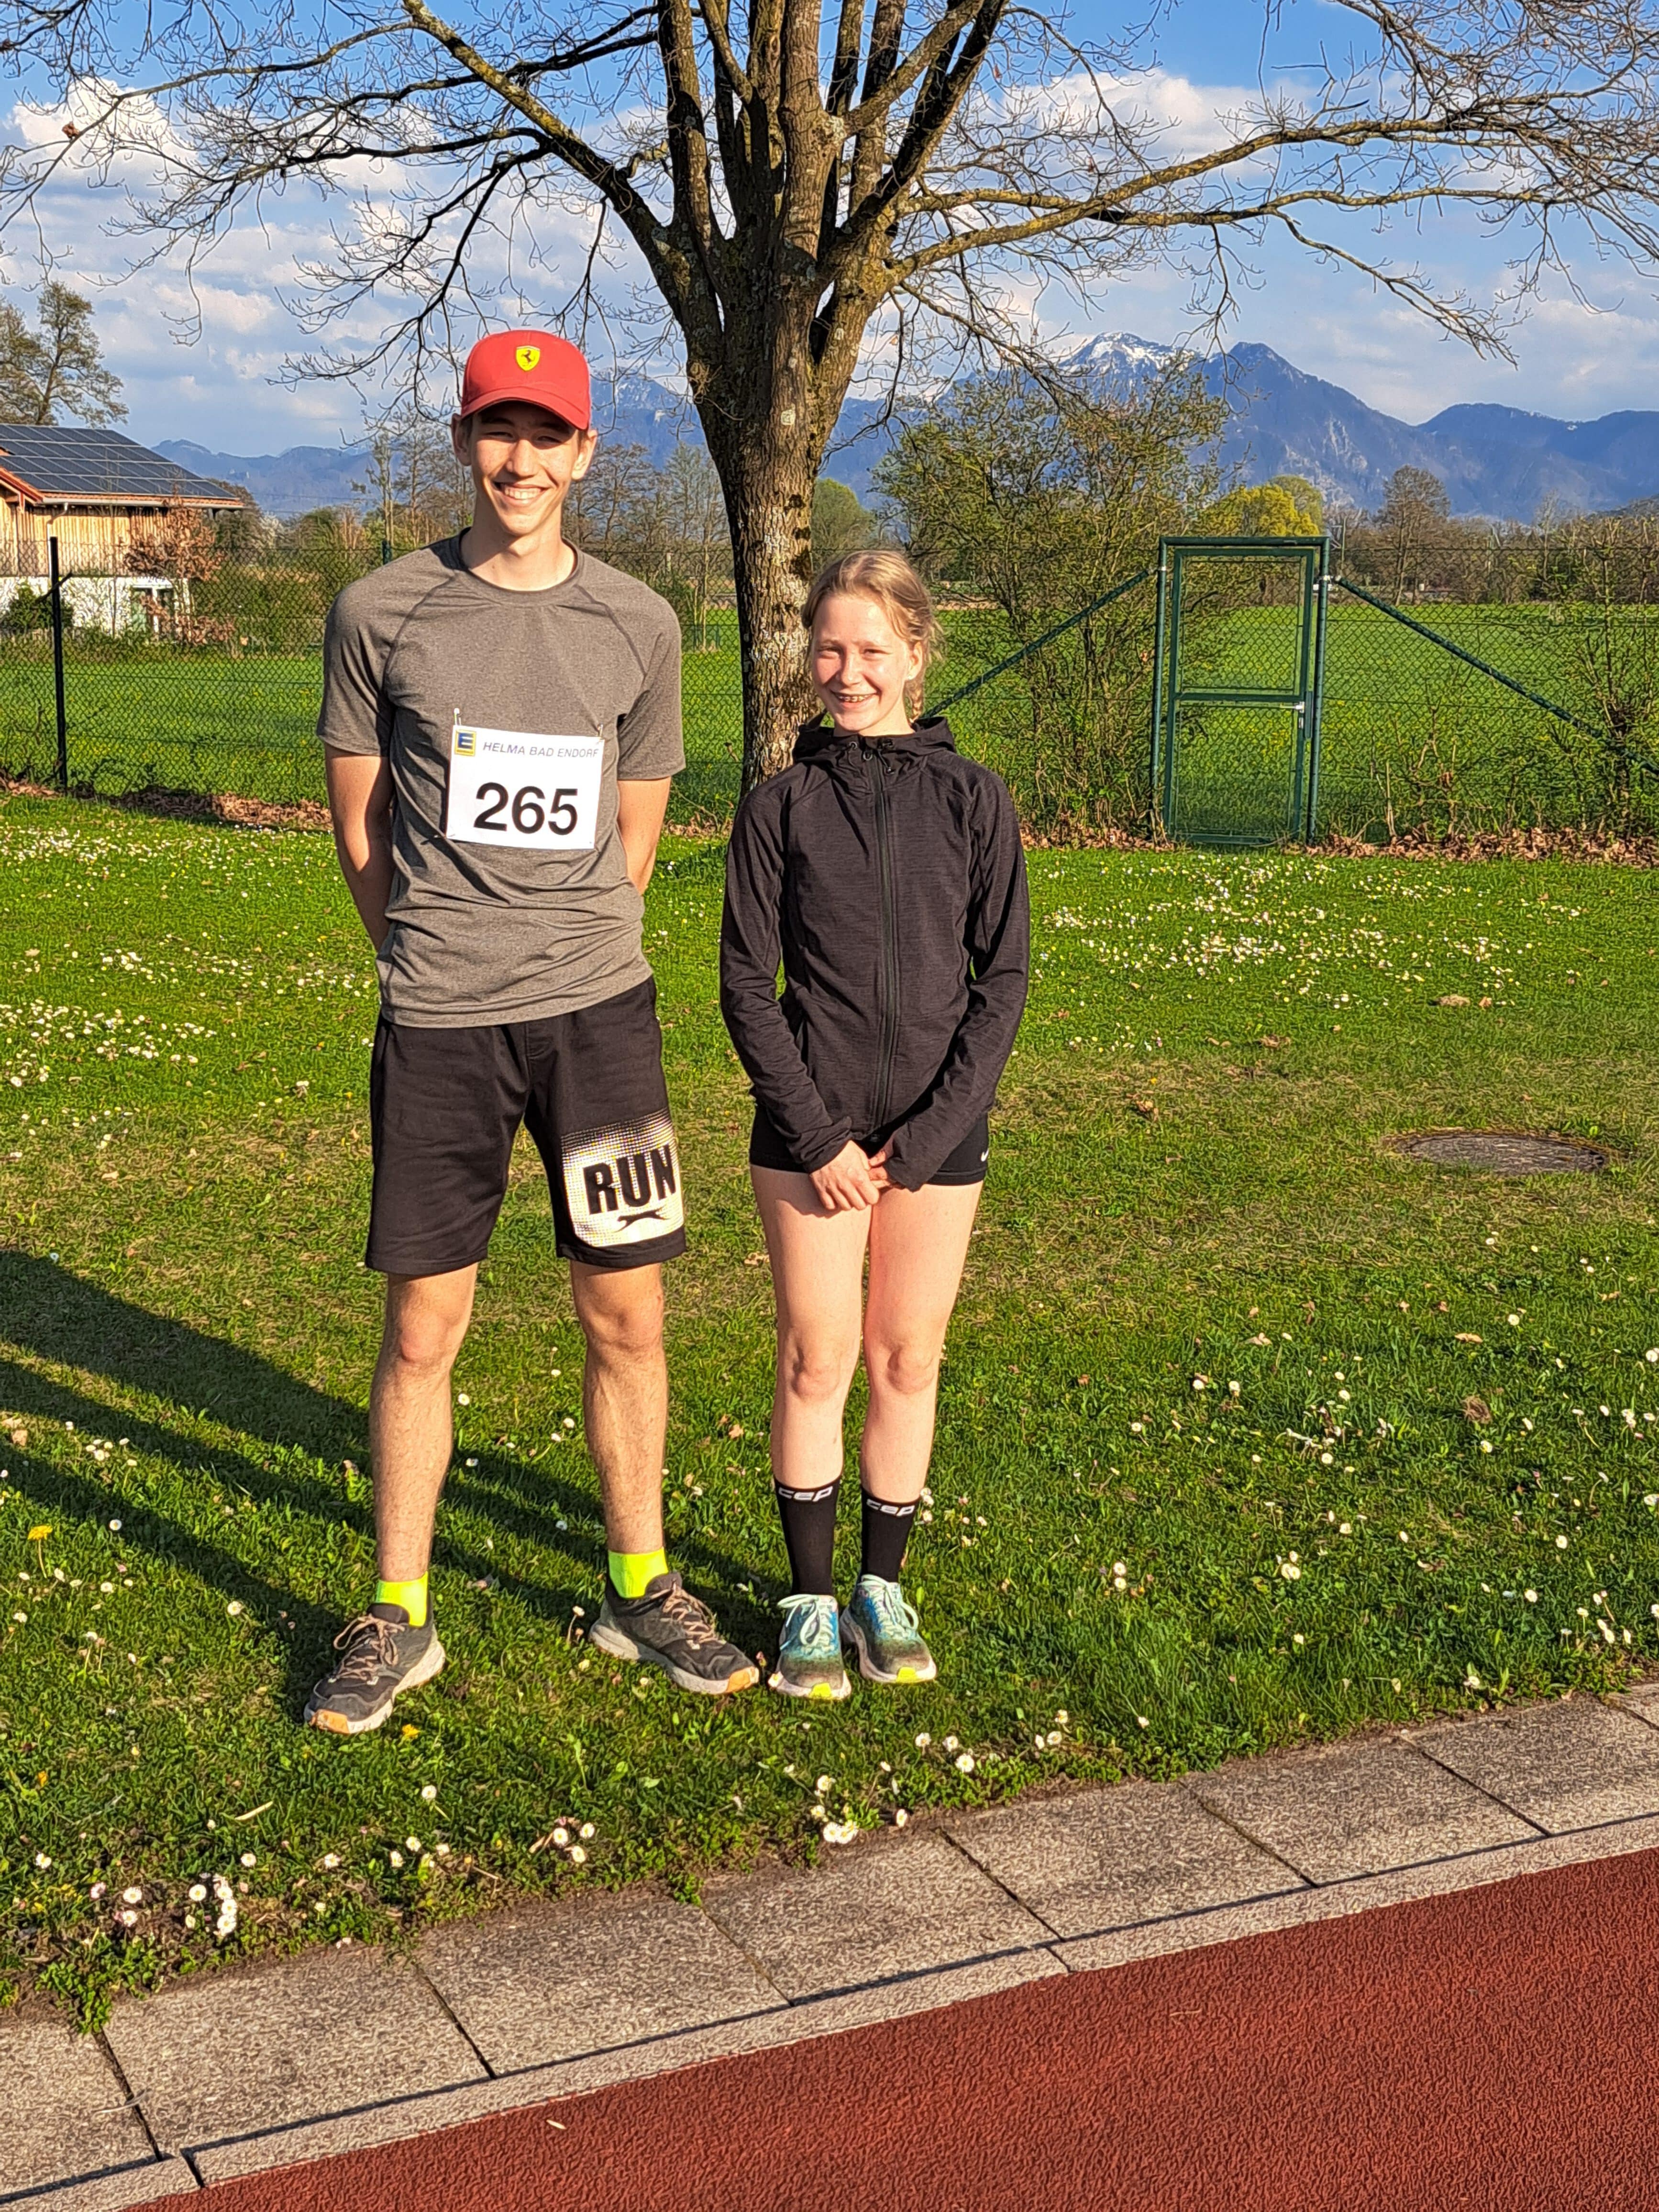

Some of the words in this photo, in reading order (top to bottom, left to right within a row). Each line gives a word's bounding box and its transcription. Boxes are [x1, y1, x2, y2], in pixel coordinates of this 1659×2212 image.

[458, 732, 473, 749] E
[483, 742, 525, 754] HELMA
[530, 747, 553, 757] BAD
[558, 749, 599, 758] ENDORF
[474, 782, 578, 835] 265
[583, 1144, 675, 1215] RUN
